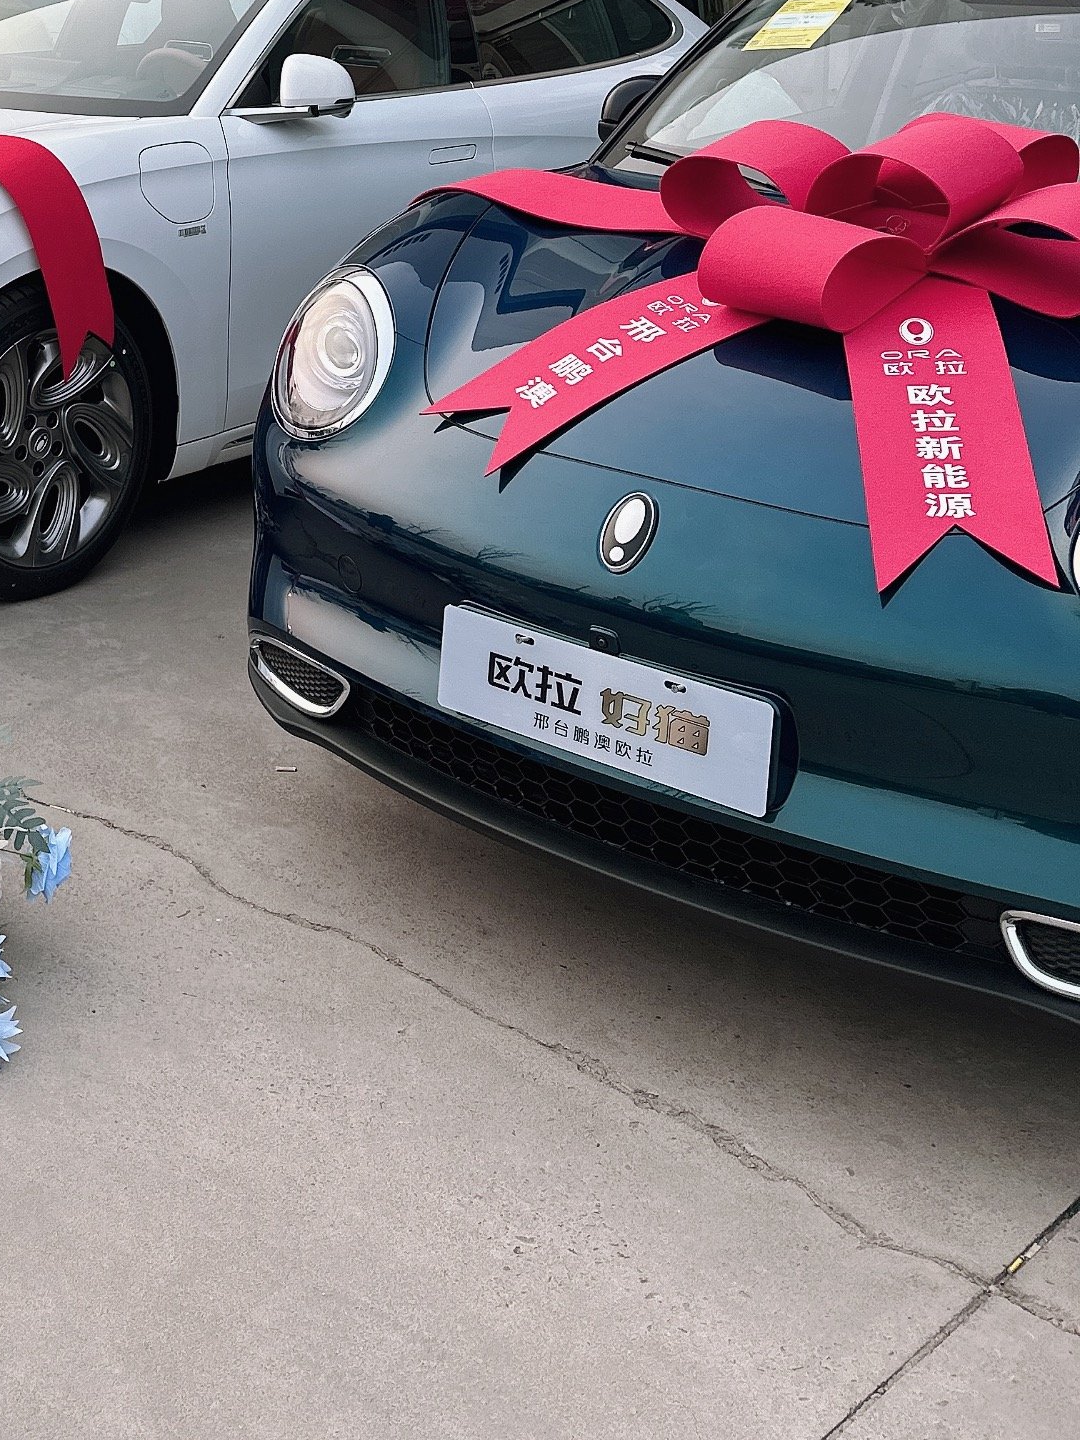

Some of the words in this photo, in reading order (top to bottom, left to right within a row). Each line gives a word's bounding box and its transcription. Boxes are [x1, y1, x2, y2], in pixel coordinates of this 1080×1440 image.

[647, 300, 700, 333] 欧拉
[666, 295, 712, 324] ORA
[515, 315, 667, 409] 邢台鹏澳
[880, 348, 963, 360] ORA
[883, 360, 968, 376] 欧拉
[906, 383, 977, 519] 欧拉新能源
[487, 651, 583, 716] 欧拉
[600, 687, 711, 757] 好猫
[533, 711, 654, 768] 邢台鹏澳欧拉
